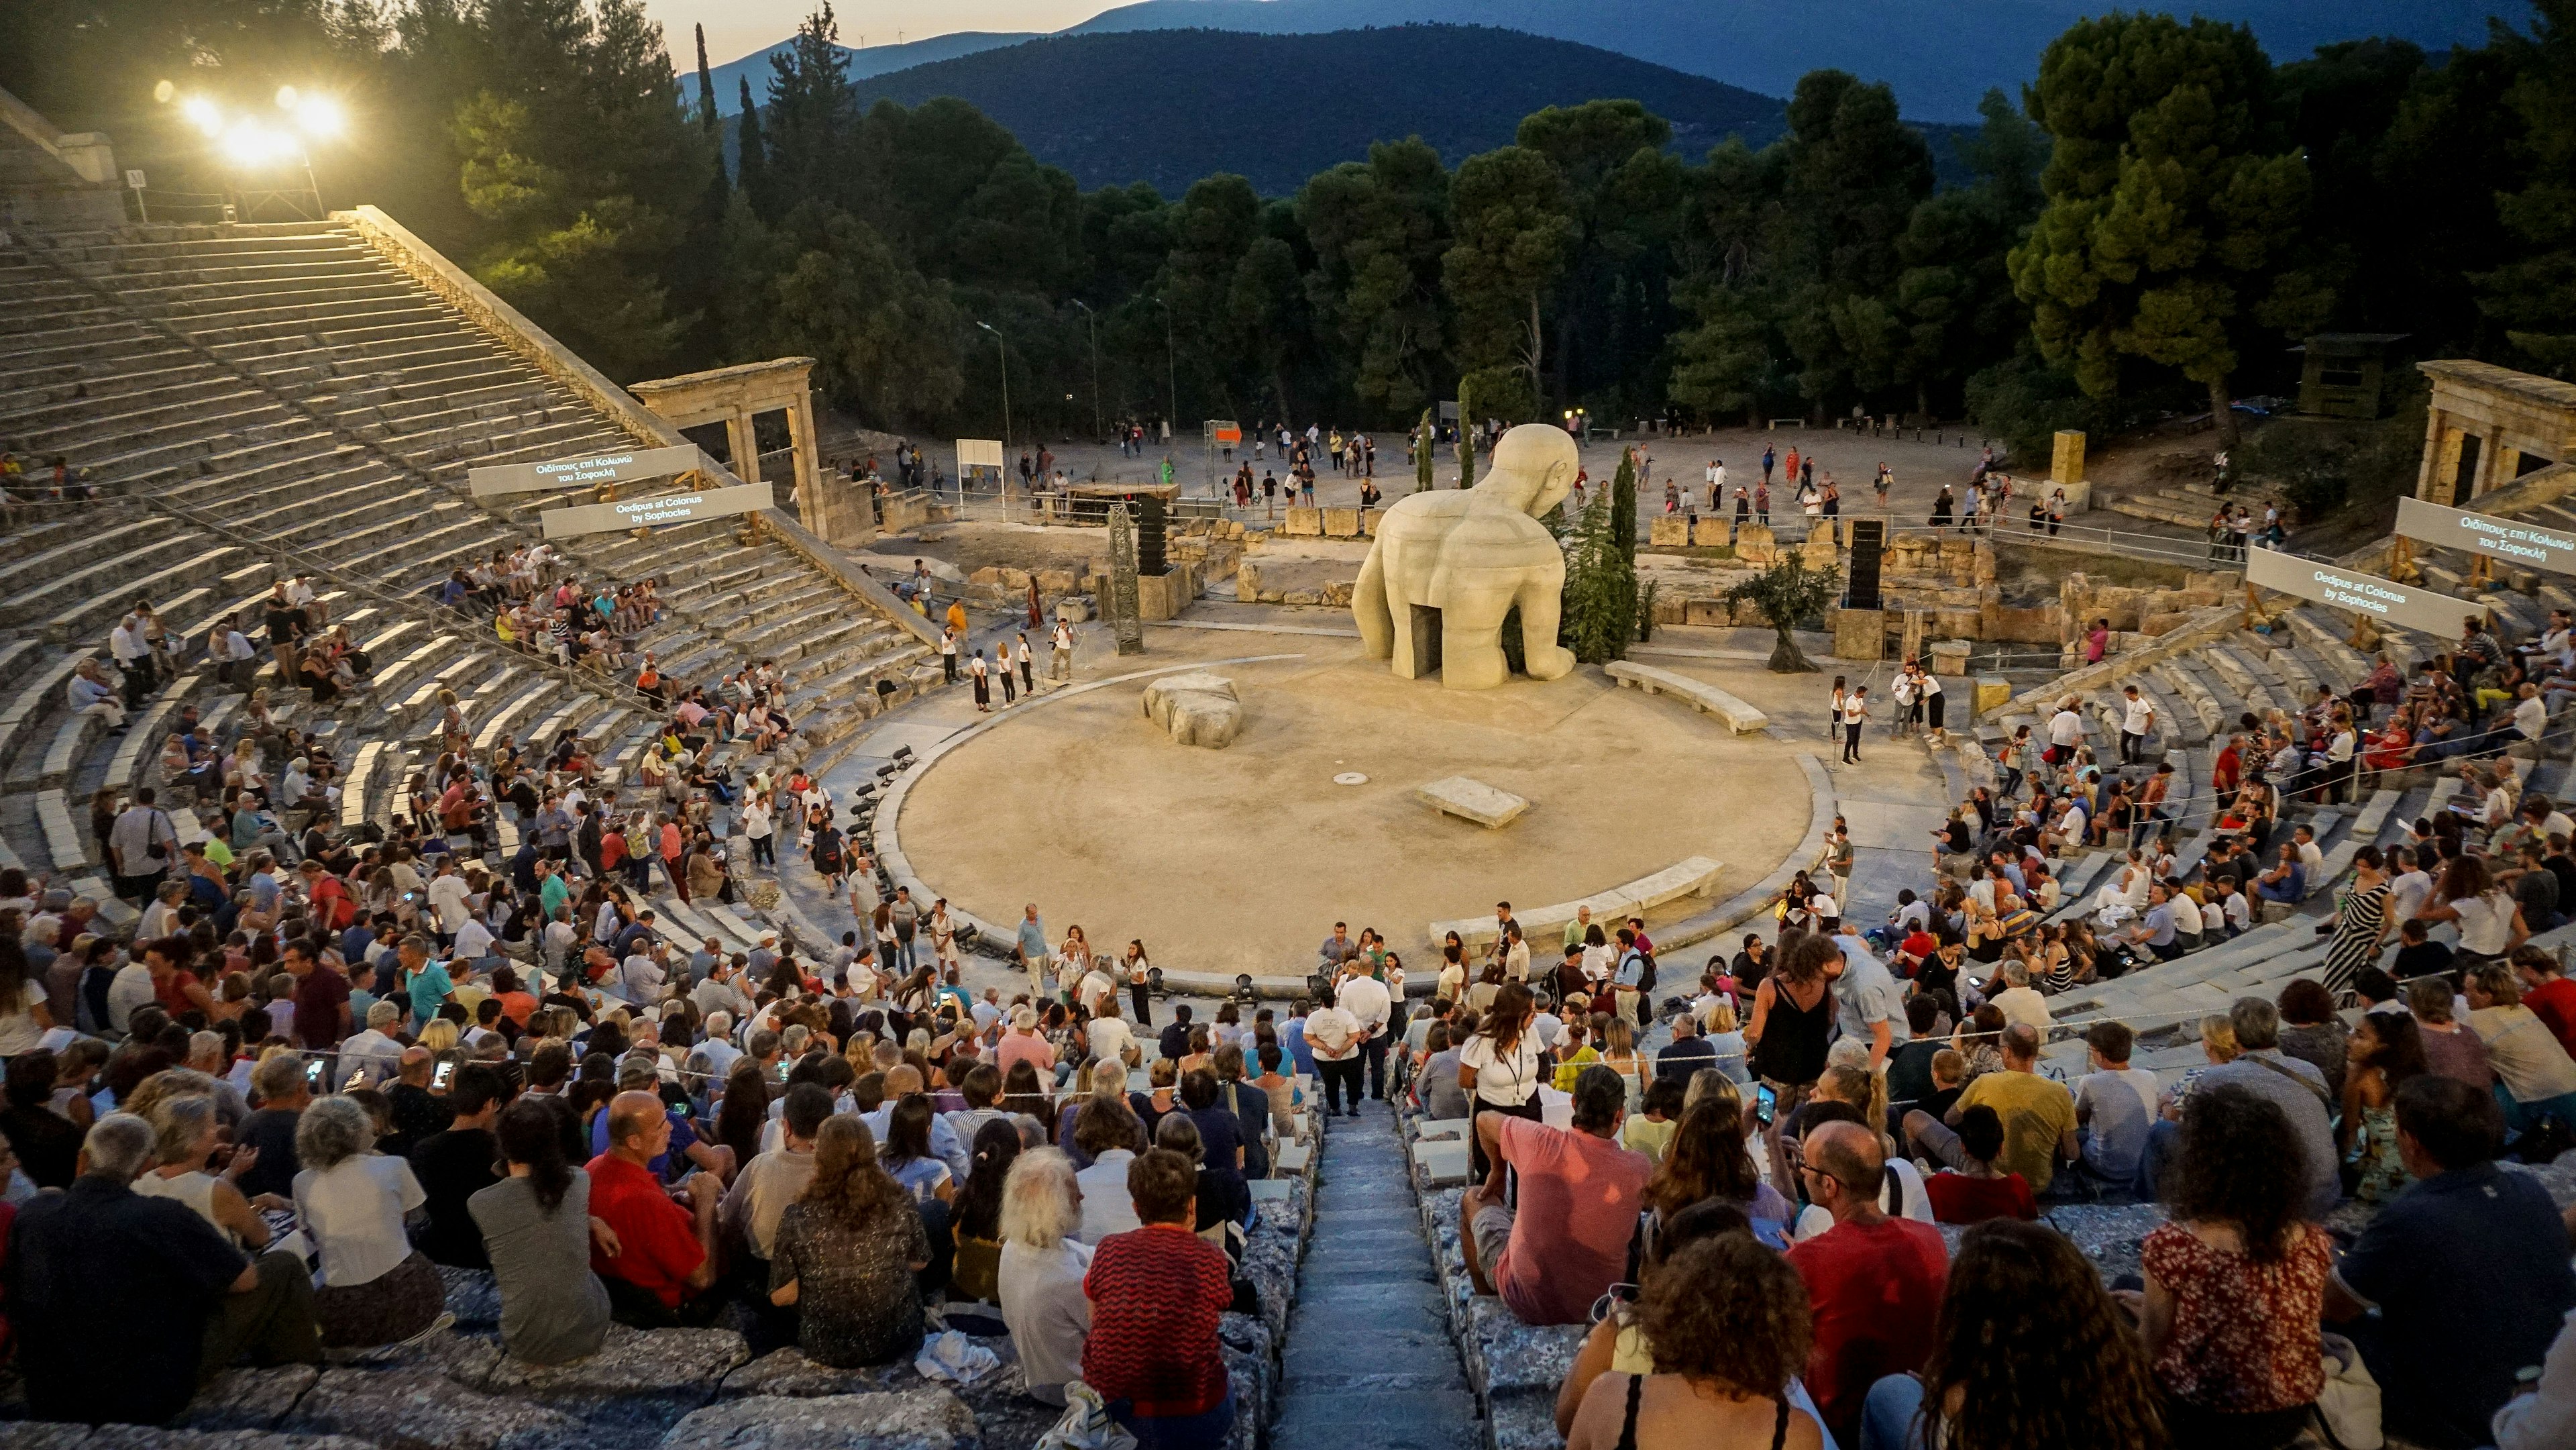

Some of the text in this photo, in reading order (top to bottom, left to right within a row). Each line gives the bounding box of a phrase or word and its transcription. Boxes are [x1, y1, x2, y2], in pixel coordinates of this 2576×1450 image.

[536, 455, 633, 474] Οιδίπους επί Κολωνώ
[557, 468, 616, 482] του Σοφοκλή
[616, 496, 702, 513] Oedipus at Colonus
[632, 508, 691, 523] by Sophocles
[2461, 517, 2575, 551] Οιδίπους επί Κολωνώ
[2479, 537, 2547, 562] του Σοφοκλή
[2314, 571, 2406, 603] Oedipus at Colonus
[2324, 588, 2388, 613] by Sophocles
